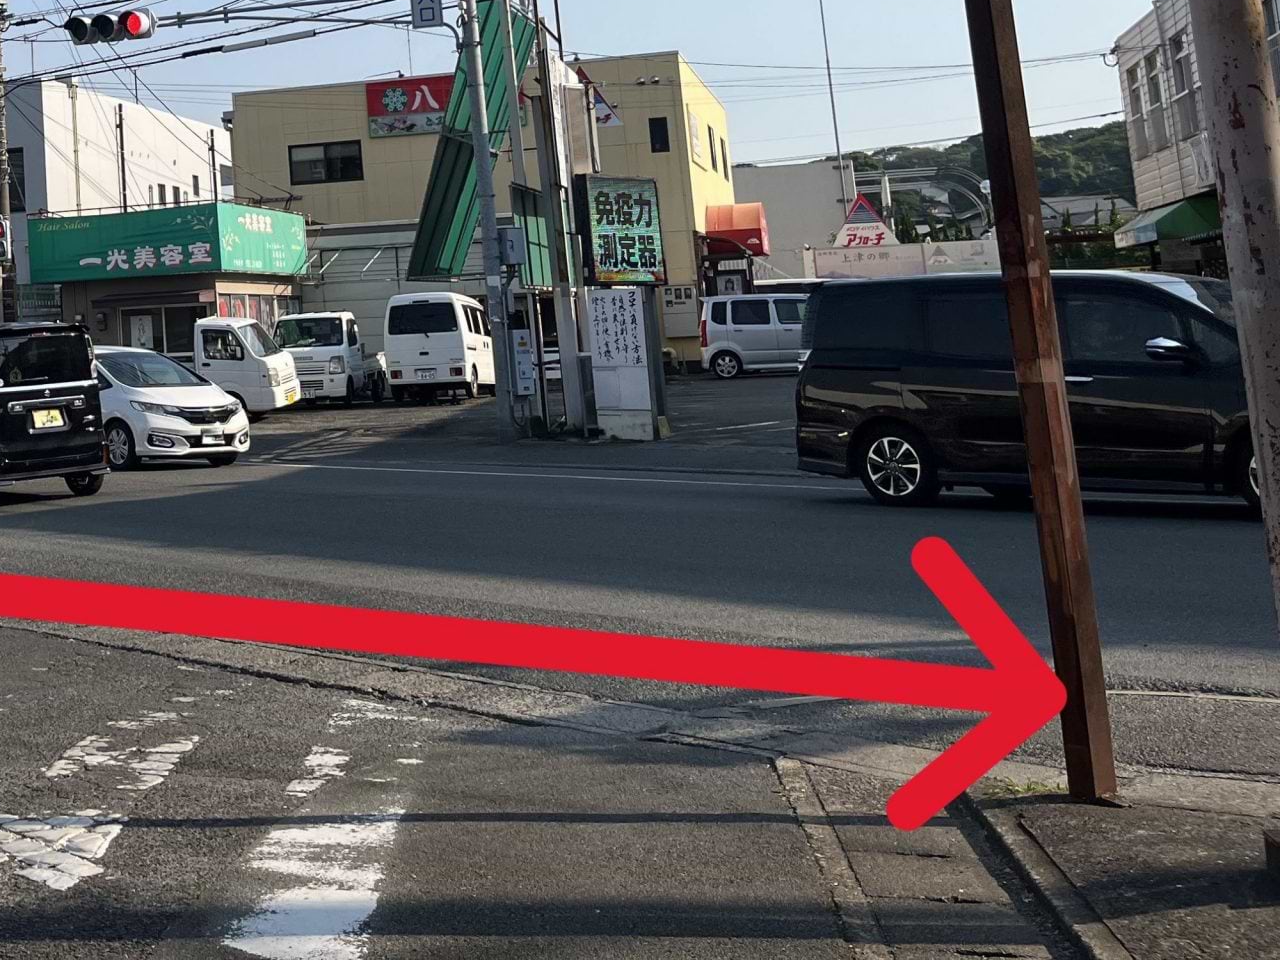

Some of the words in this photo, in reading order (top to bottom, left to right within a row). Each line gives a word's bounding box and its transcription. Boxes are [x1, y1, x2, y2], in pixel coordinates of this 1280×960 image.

[37, 222, 61, 232] Hair
[63, 219, 90, 230] Salon
[594, 191, 652, 228] 免疫力
[79, 241, 212, 271] 一光美容室
[598, 233, 657, 268] 測定器
